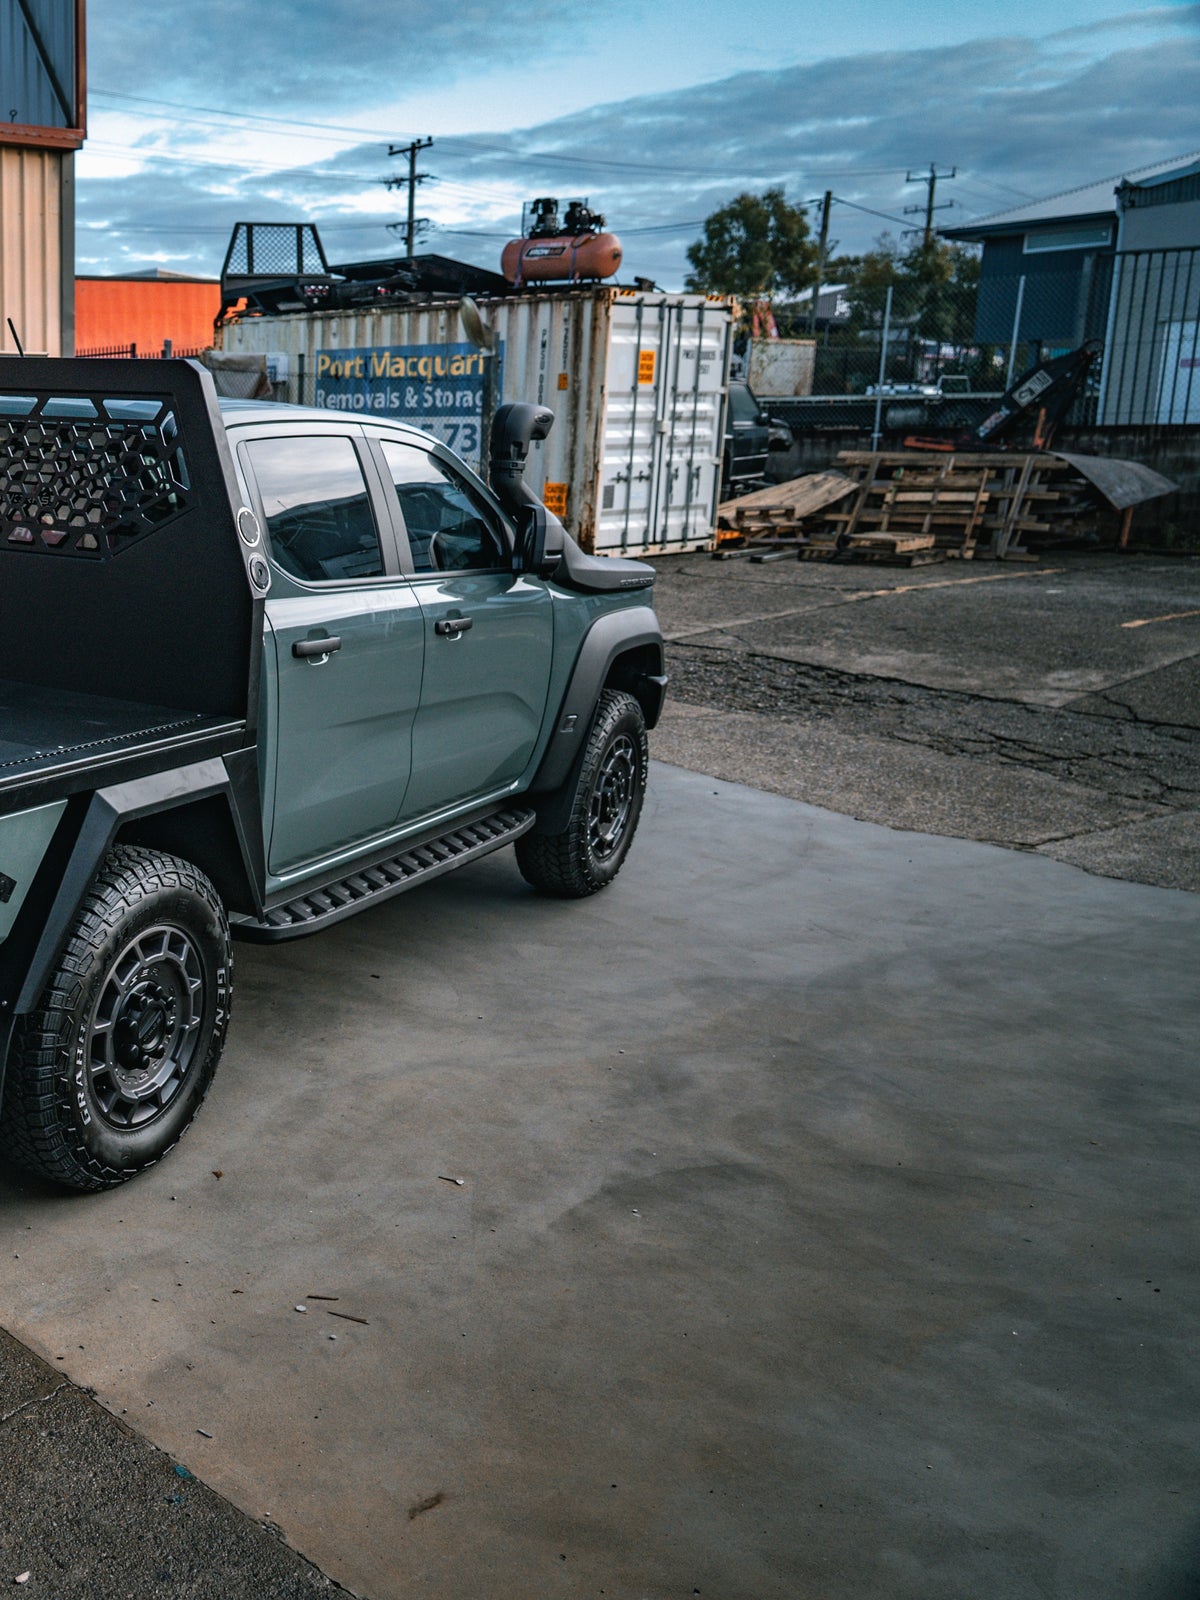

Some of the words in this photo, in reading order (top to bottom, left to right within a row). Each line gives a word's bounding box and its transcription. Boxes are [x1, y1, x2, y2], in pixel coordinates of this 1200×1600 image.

[317, 354, 364, 380] Port
[370, 351, 484, 384] Macquari
[317, 386, 400, 410] Removals
[404, 386, 419, 408] &
[423, 385, 488, 412] Storag
